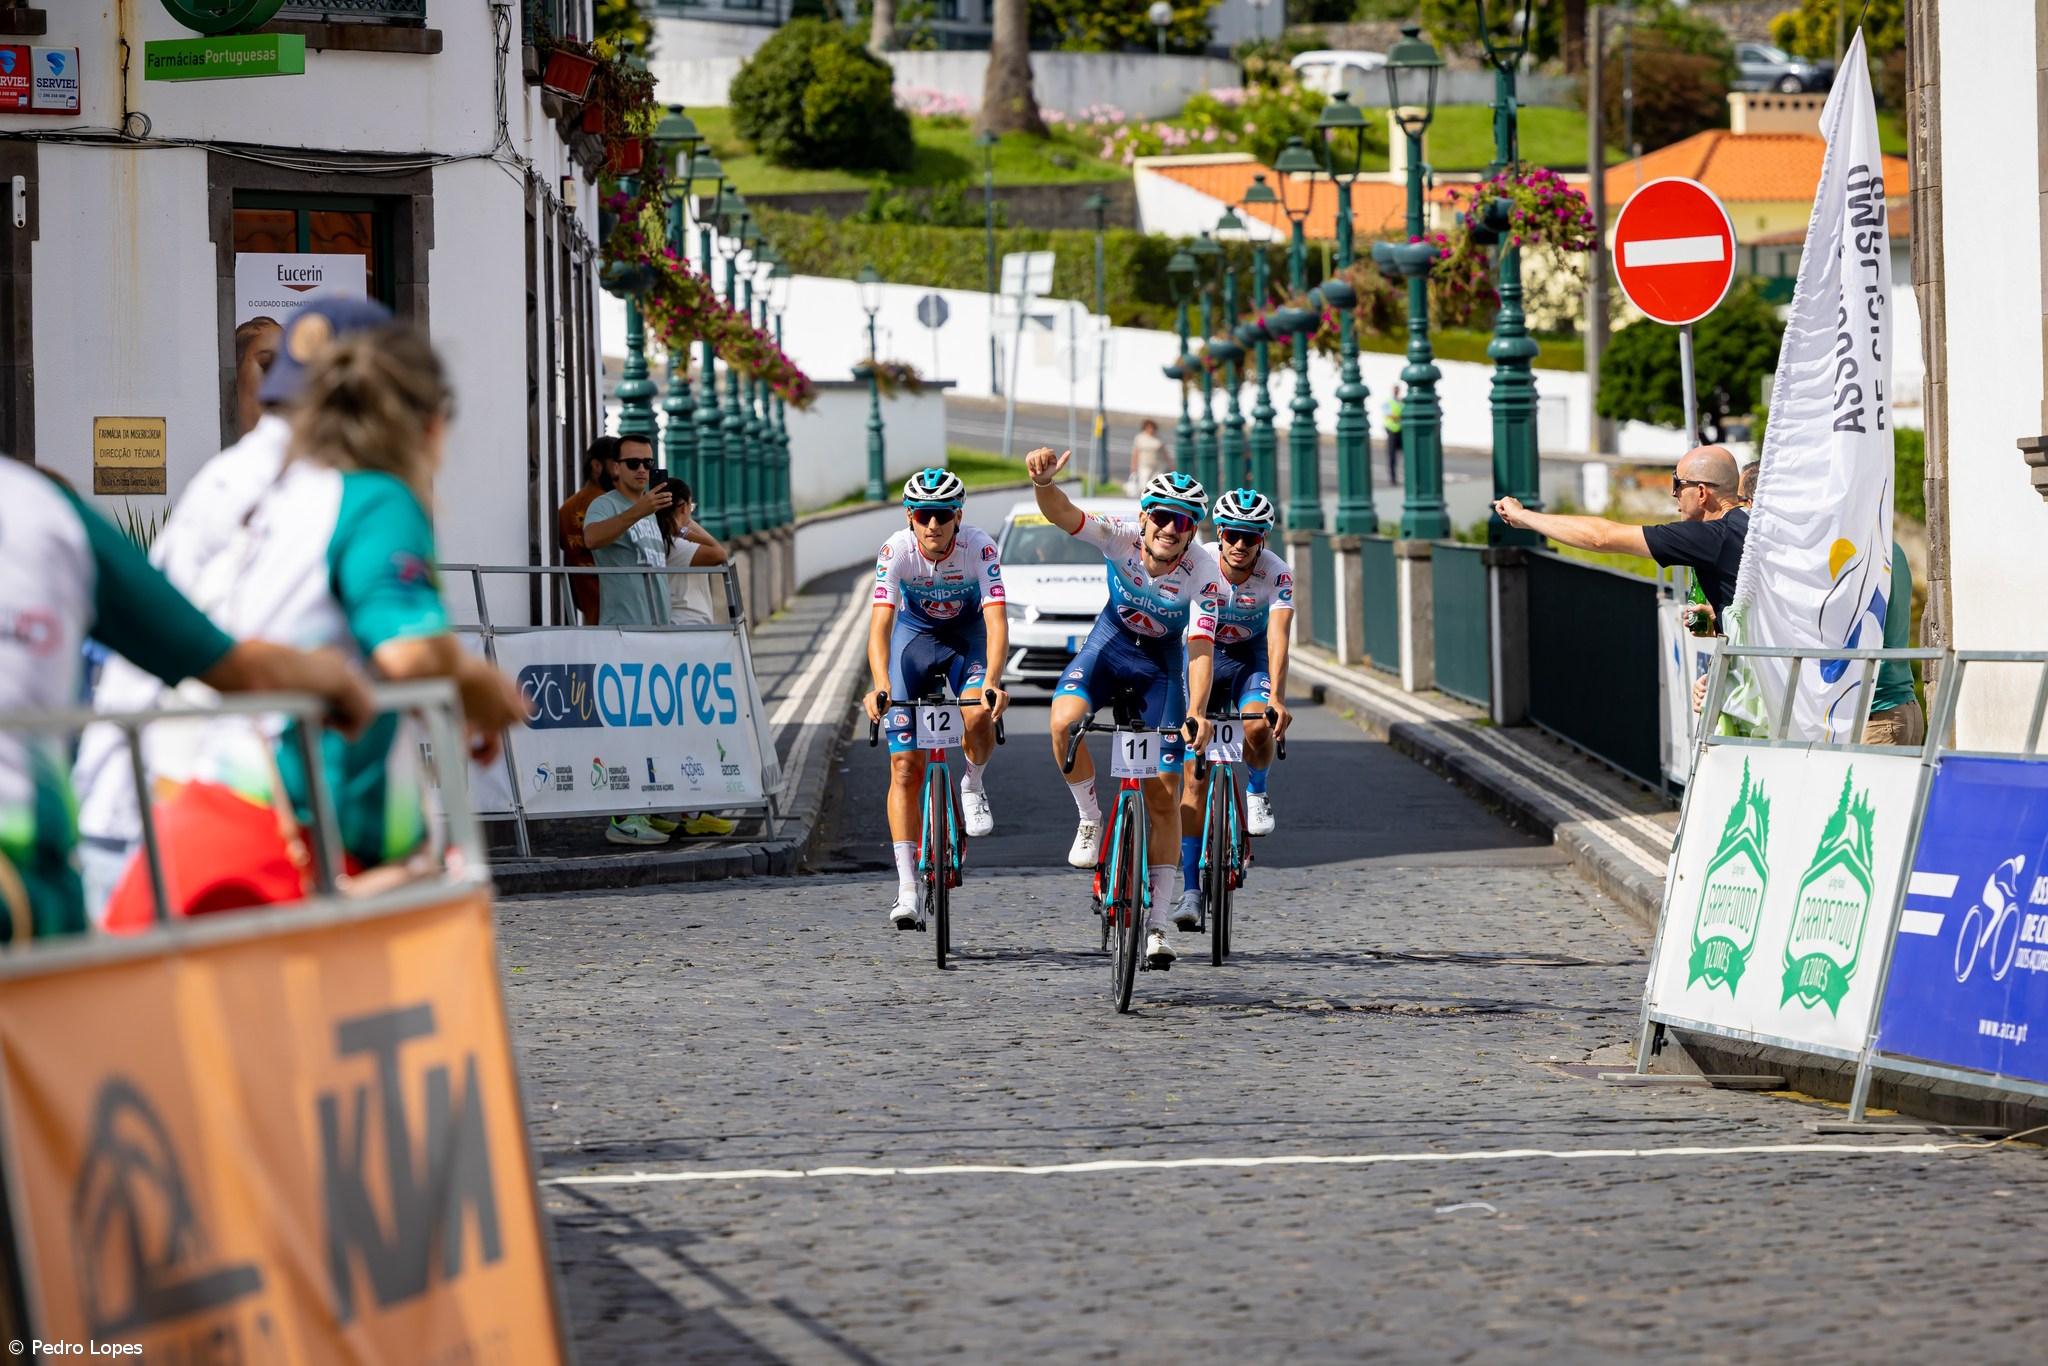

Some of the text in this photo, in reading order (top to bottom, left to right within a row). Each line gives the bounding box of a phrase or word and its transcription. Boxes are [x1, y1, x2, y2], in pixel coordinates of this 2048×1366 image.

[36, 78, 78, 89] SERVIEL
[277, 264, 323, 282] Eucerin
[248, 300, 254, 308] O
[254, 300, 281, 308] CUIDADO
[122, 428, 130, 439] DA
[99, 448, 161, 460] DIRECÇÃO TÉCNICA
[597, 662, 738, 727] azores
[926, 711, 951, 732] 12
[1212, 724, 1233, 744] 10
[1125, 738, 1148, 760] 11
[1703, 883, 1757, 934] GRANFONDO
[1796, 897, 1860, 950] GRANFONDO
[1704, 941, 1733, 974] AZORES
[1799, 957, 1832, 992] AZORES
[1978, 1019, 2028, 1046] www.aca.pt
[315, 1000, 506, 1328] KTM
